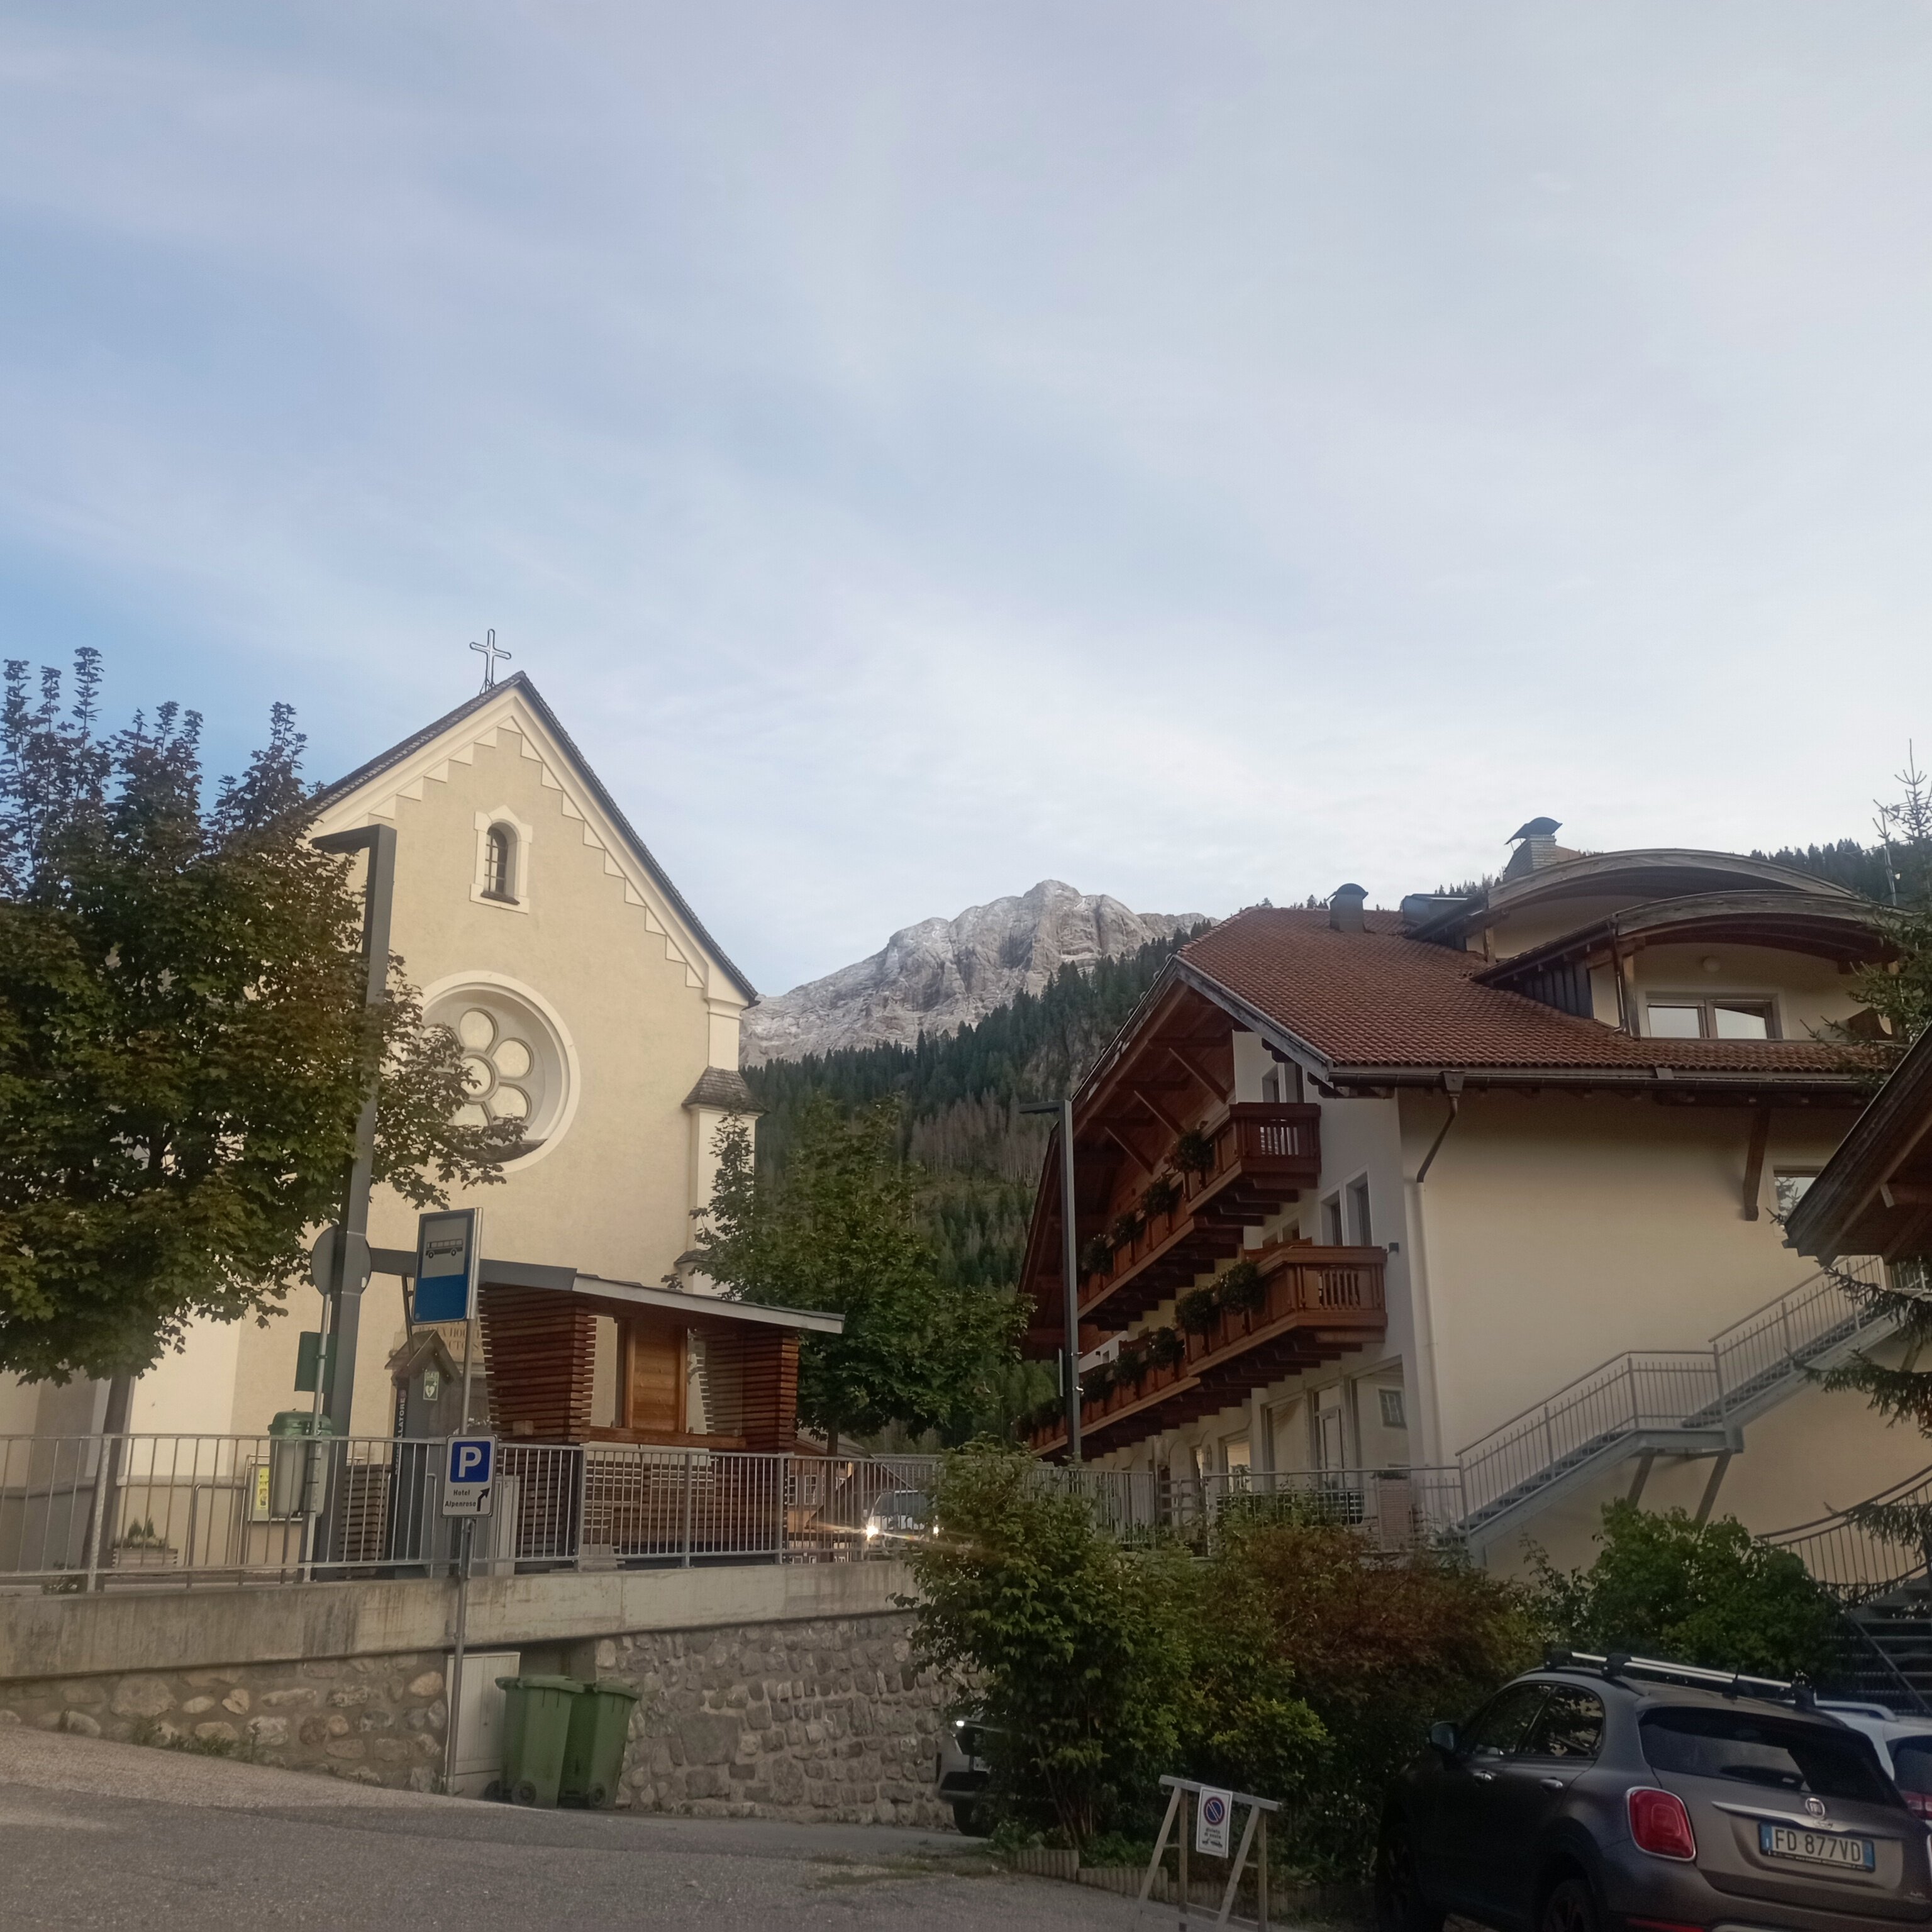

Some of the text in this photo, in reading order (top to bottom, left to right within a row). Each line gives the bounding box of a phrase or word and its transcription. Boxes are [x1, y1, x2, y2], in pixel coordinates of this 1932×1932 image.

[458, 1446, 482, 1478] P
[1775, 1829, 1797, 1852] FD
[1805, 1834, 1861, 1862] 877VD
